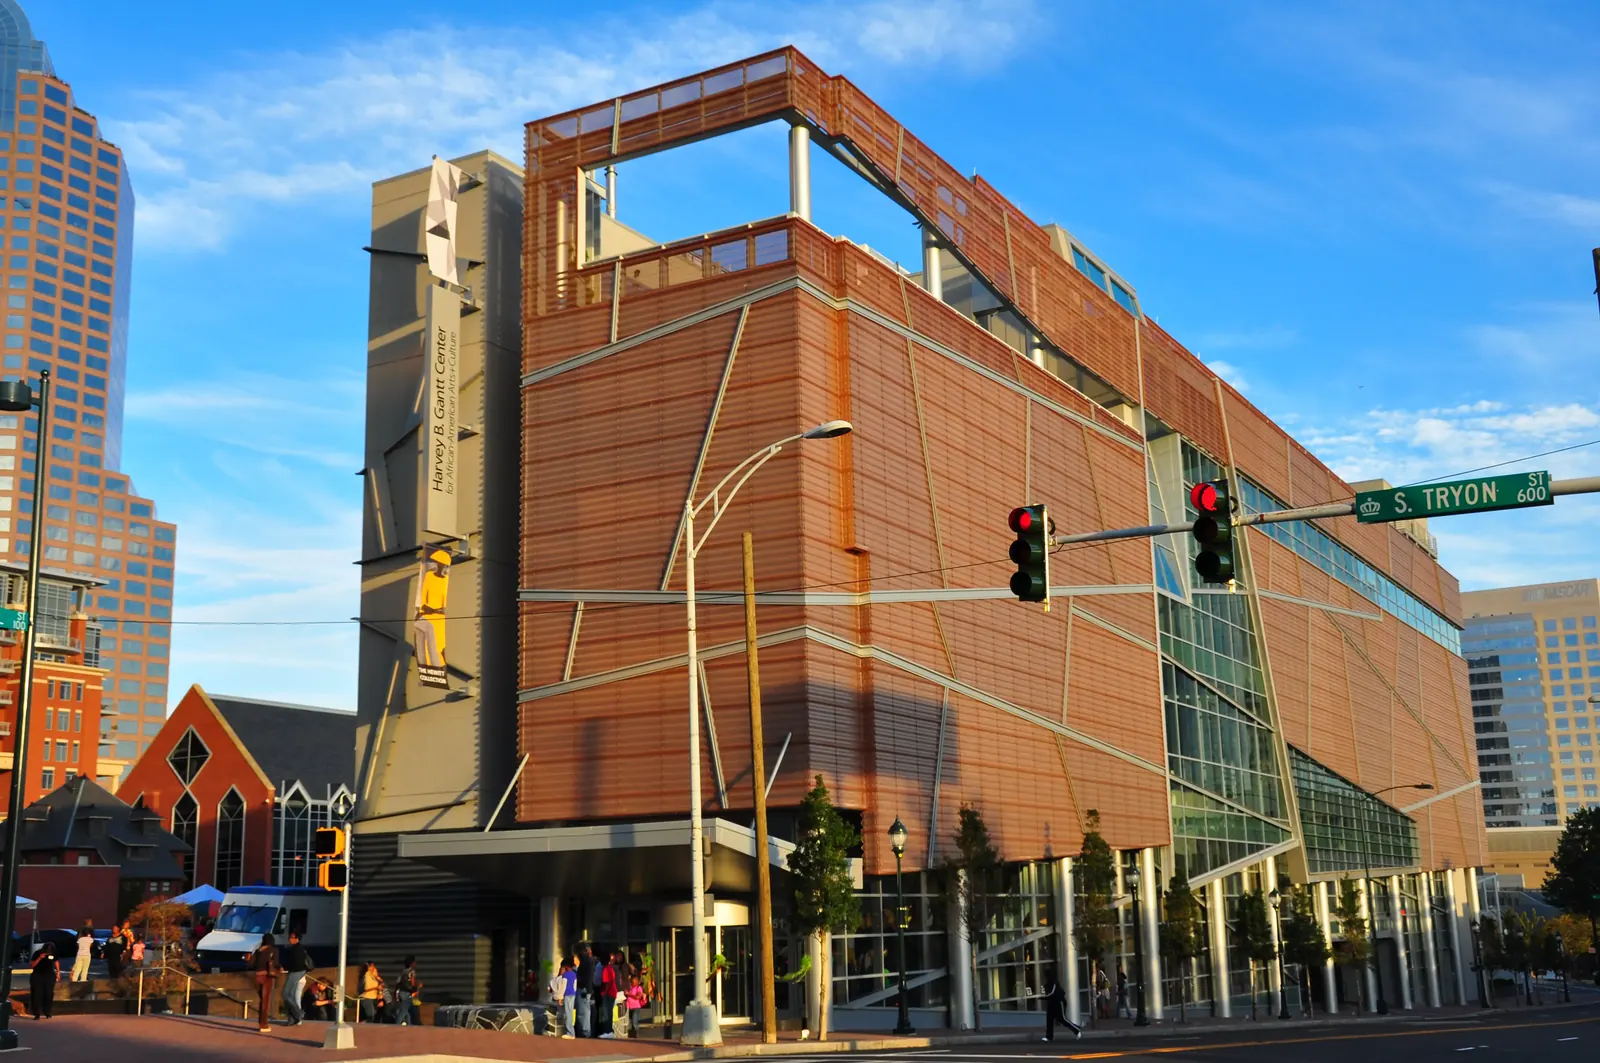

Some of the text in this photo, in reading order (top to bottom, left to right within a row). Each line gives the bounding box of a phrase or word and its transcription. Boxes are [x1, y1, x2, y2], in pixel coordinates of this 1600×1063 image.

[432, 325, 446, 492] Harvey B. Gantt Center
[445, 331, 457, 495] for African-American Arts+Culture
[1528, 471, 1545, 487] ST
[1394, 481, 1497, 514] S. TRYON
[1516, 486, 1546, 503] 600
[17, 611, 26, 620] ST
[13, 620, 26, 630] 100
